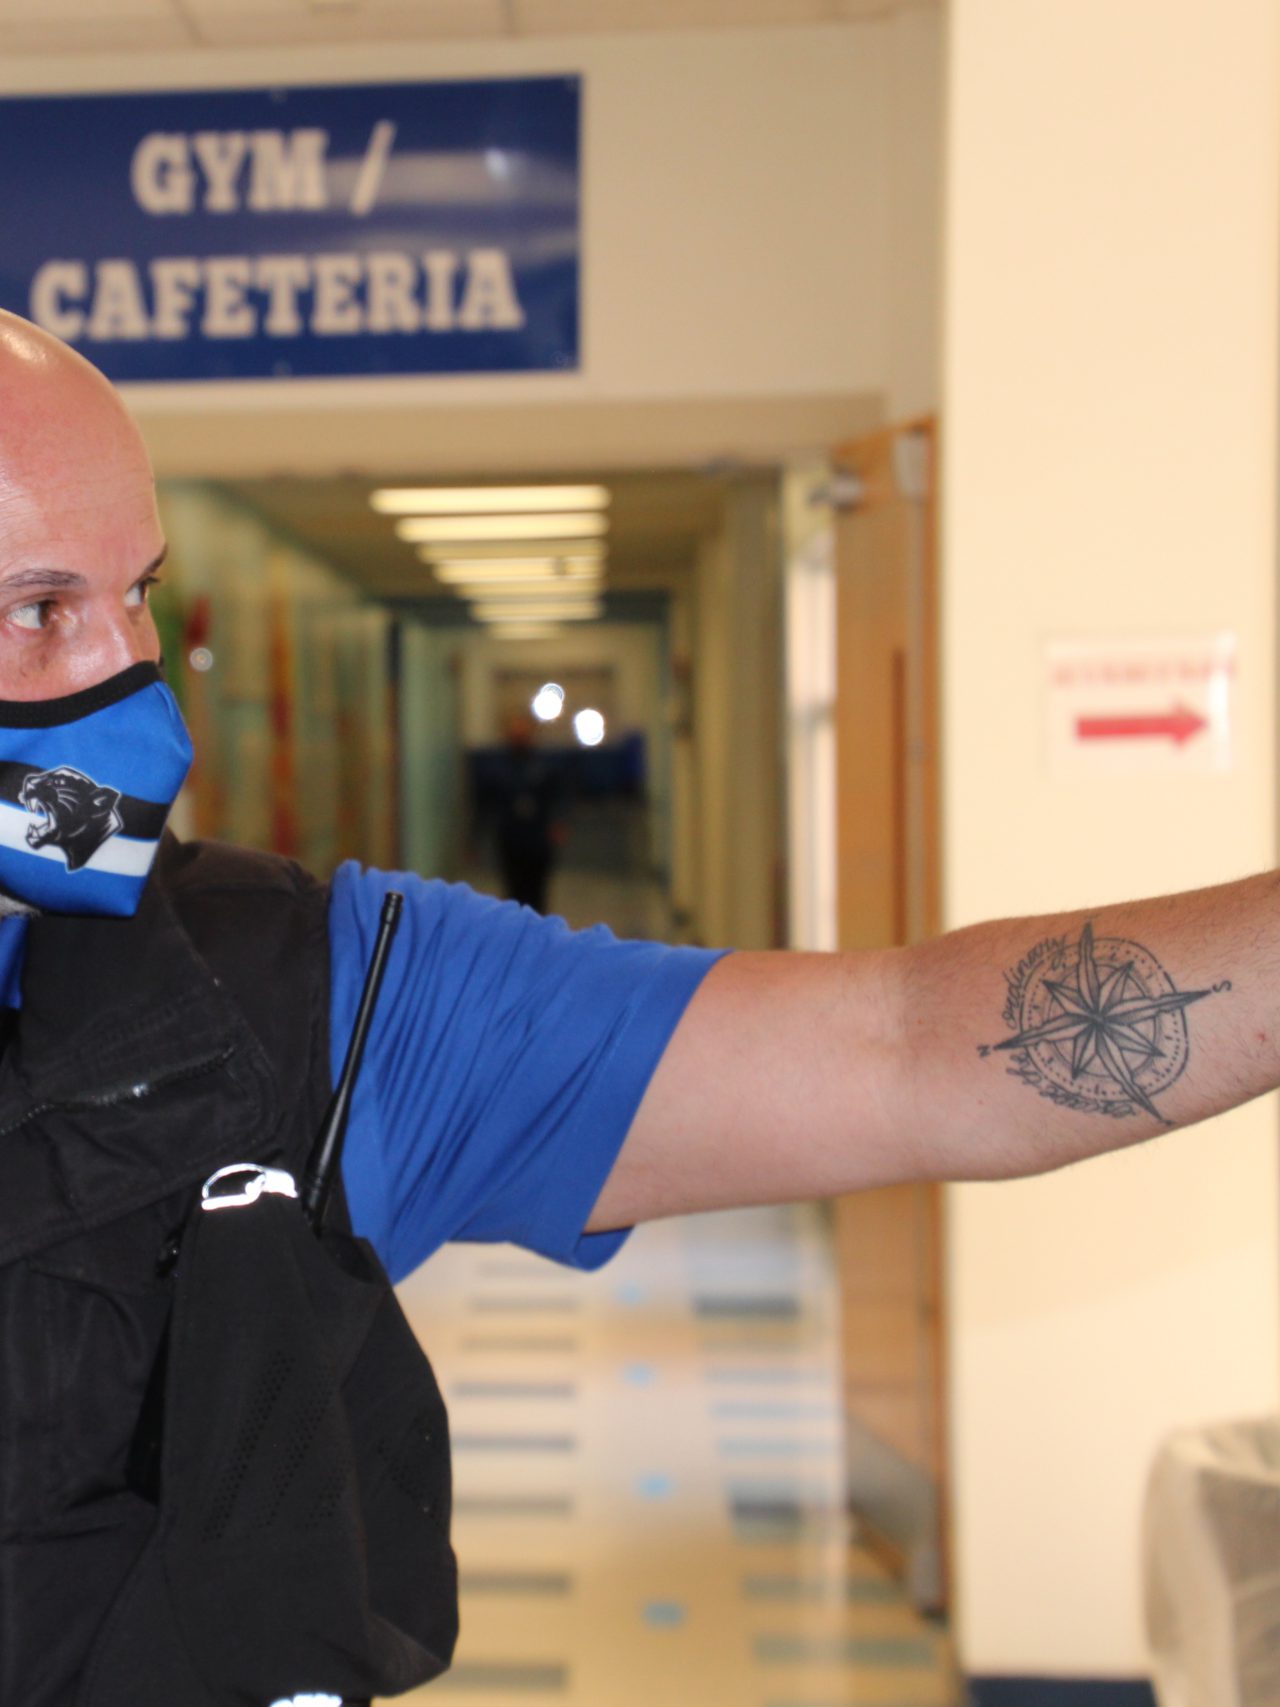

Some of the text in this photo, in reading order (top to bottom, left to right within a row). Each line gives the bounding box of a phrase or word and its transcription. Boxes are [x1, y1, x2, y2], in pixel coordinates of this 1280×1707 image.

[130, 119, 396, 217] GYM /
[29, 248, 526, 343] CAFETERIA
